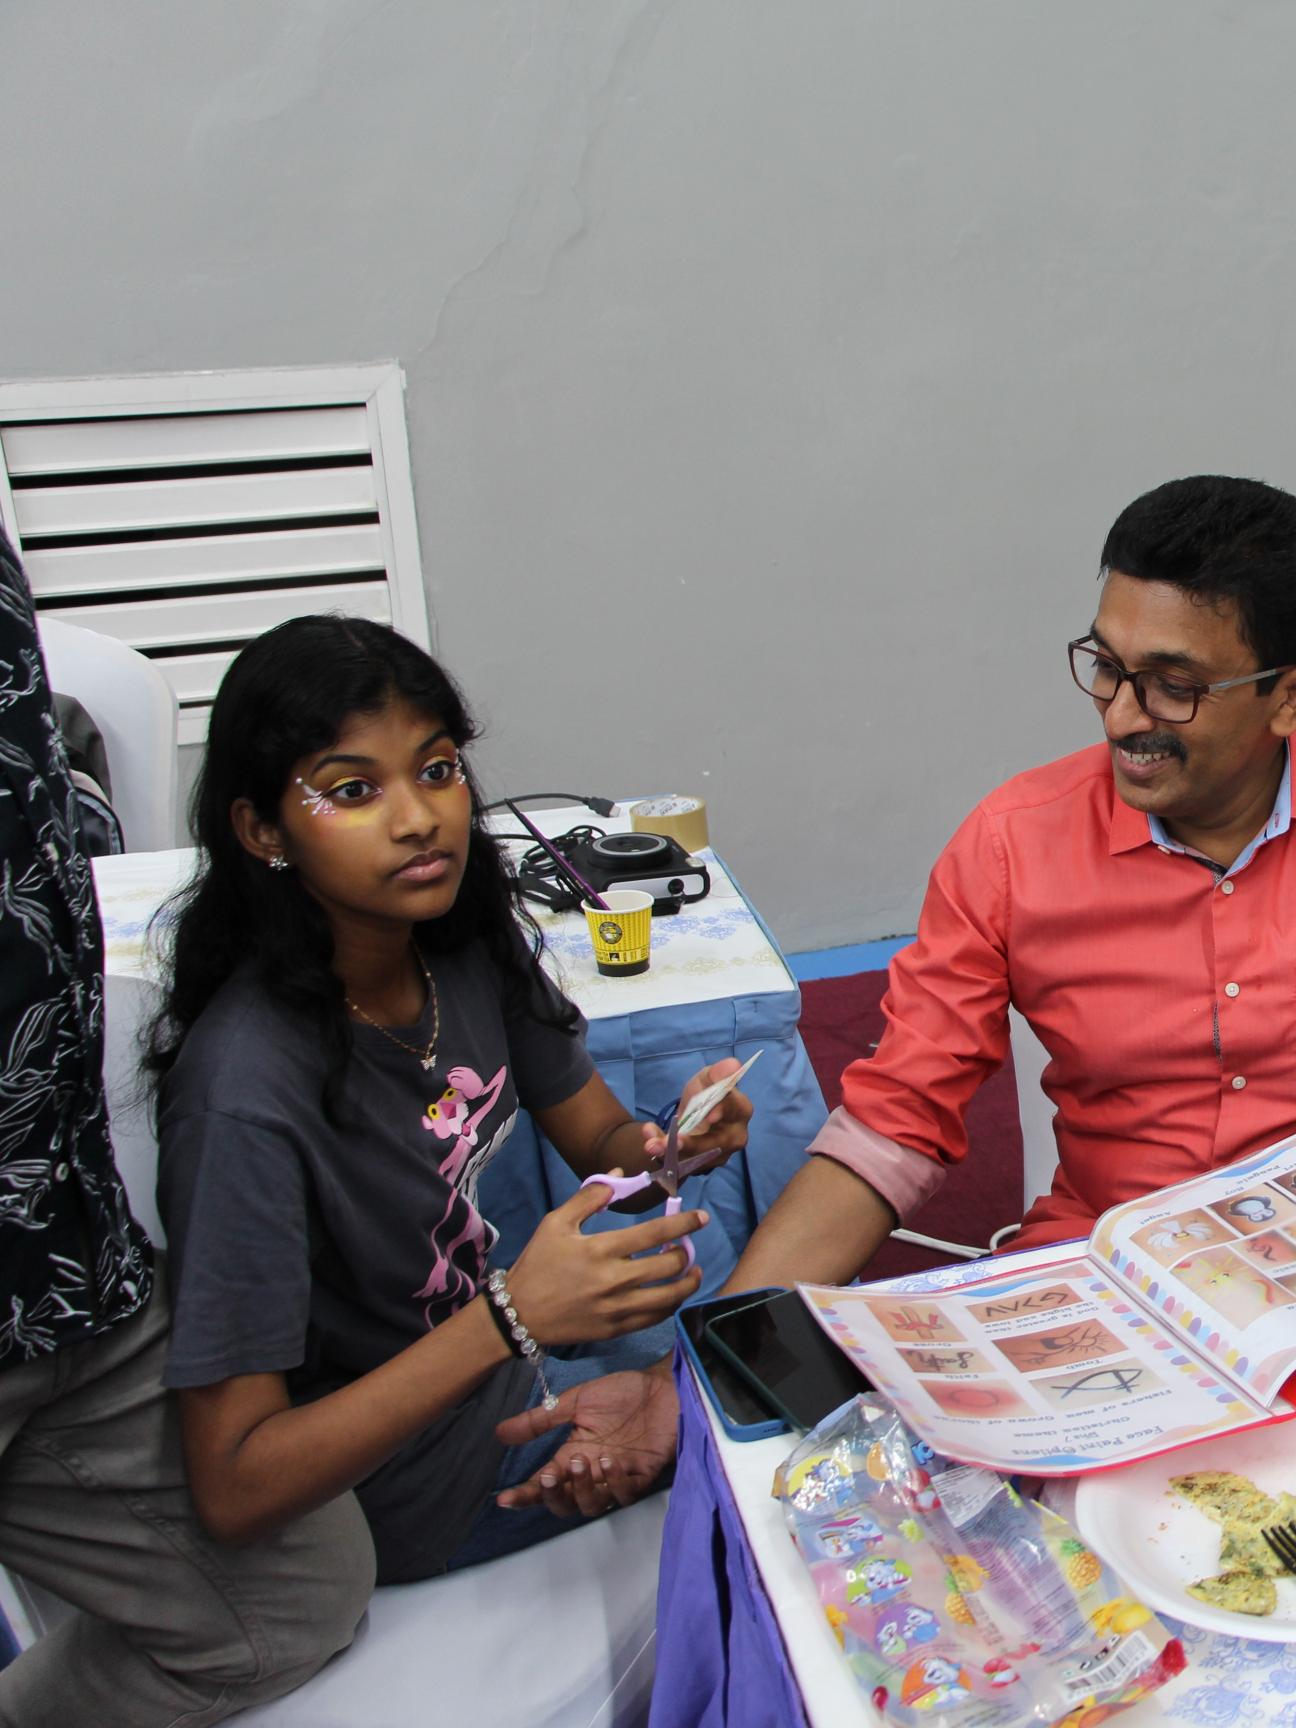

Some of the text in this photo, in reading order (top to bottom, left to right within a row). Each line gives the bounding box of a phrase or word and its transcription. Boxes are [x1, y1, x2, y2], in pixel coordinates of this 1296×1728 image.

[1236, 1164, 1281, 1186] Penguin
[1140, 1210, 1171, 1226] Angel
[1076, 1306, 1100, 1316] God
[1015, 1316, 1058, 1329] greater
[1065, 1359, 1102, 1370] Tomb
[1122, 1388, 1172, 1408] Fishers
[1100, 1404, 1116, 1413] of
[1062, 1415, 1131, 1434] Christian
[1011, 1424, 1165, 1458] Face Paint Options
